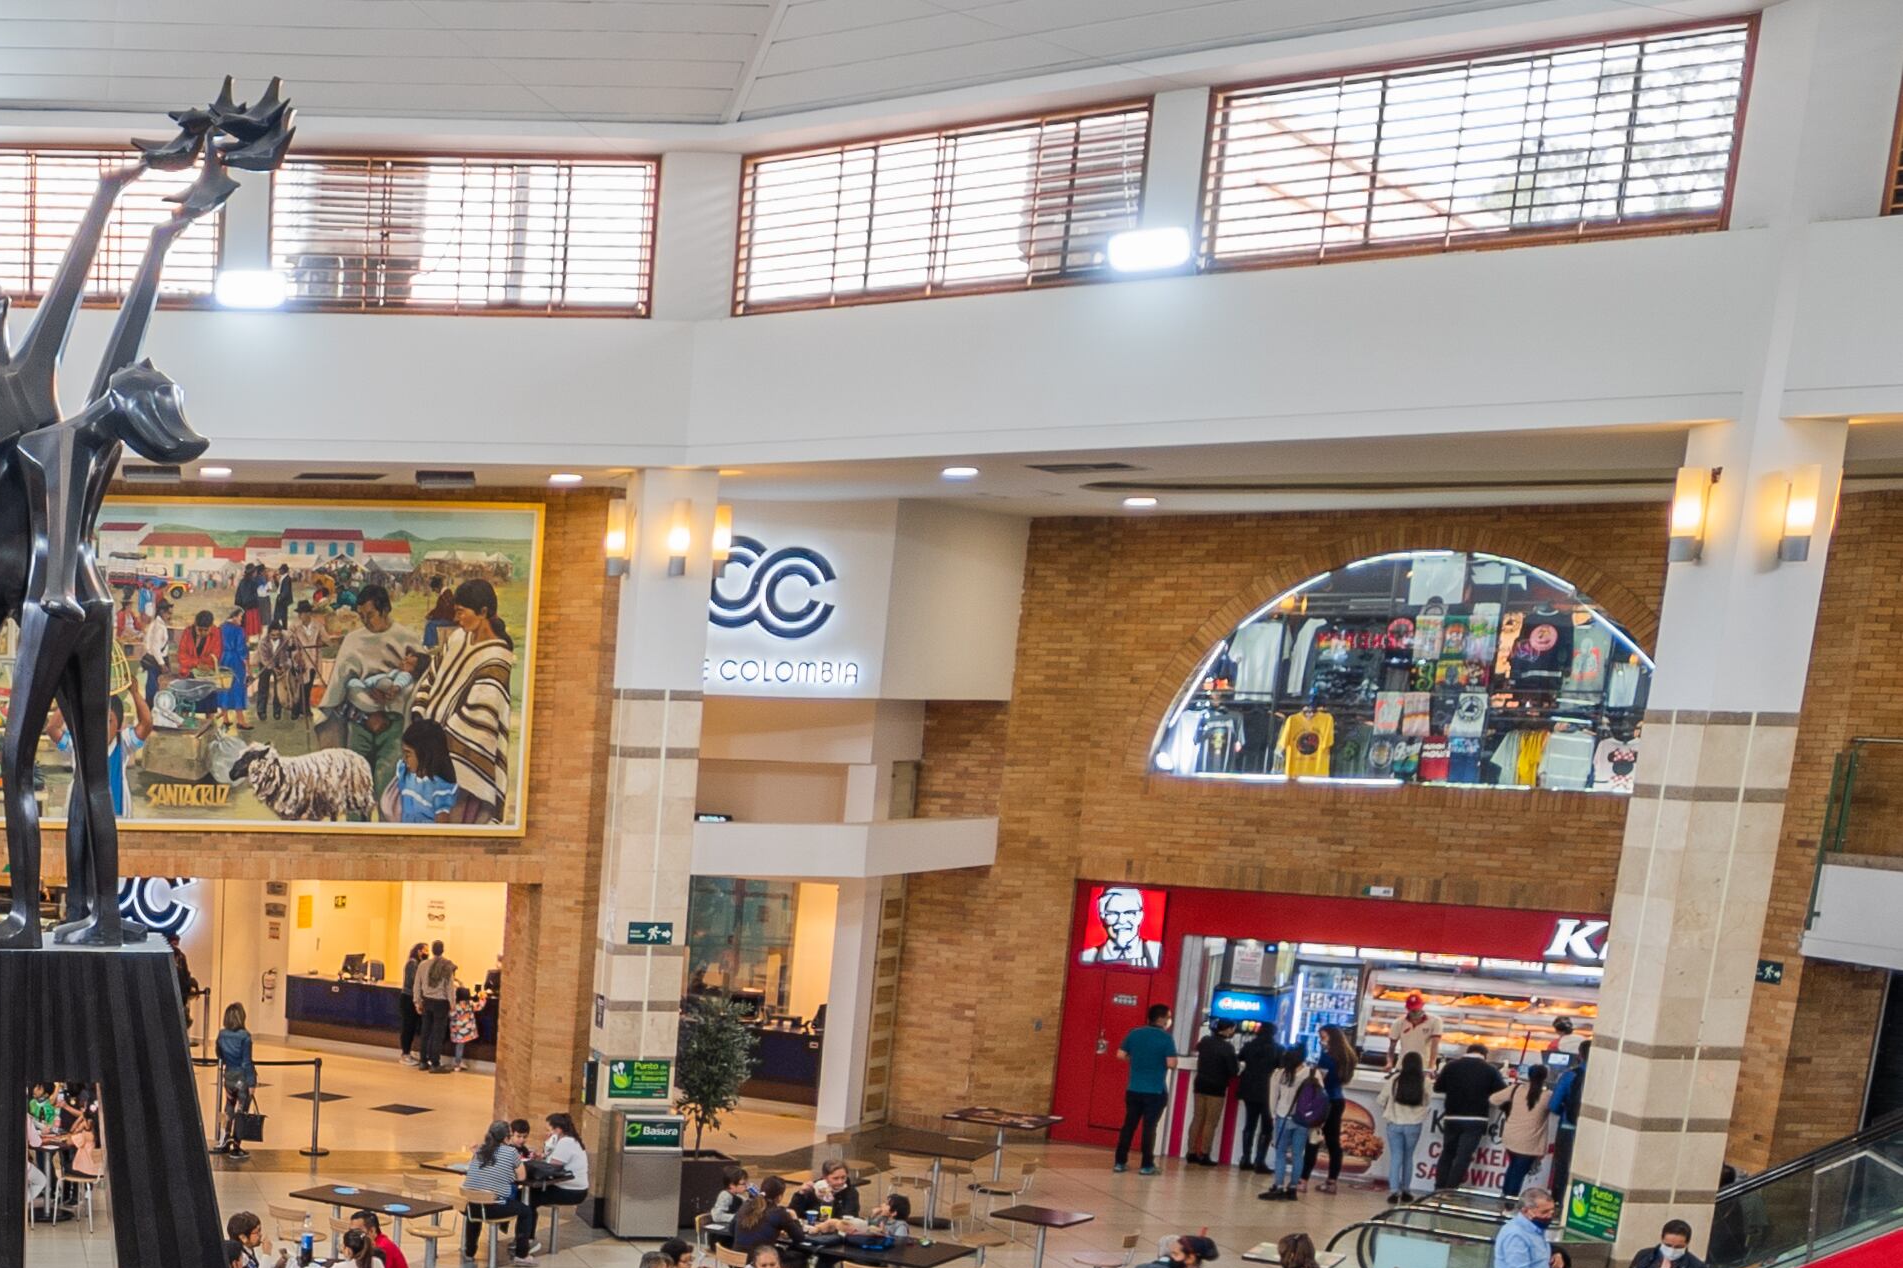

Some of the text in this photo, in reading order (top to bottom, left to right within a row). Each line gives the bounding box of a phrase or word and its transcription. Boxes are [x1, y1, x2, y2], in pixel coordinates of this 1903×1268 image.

[719, 659, 859, 684] COLOMBIA
[1543, 918, 1609, 960] K
[634, 1062, 659, 1070] Punto
[642, 1126, 679, 1136] Basura
